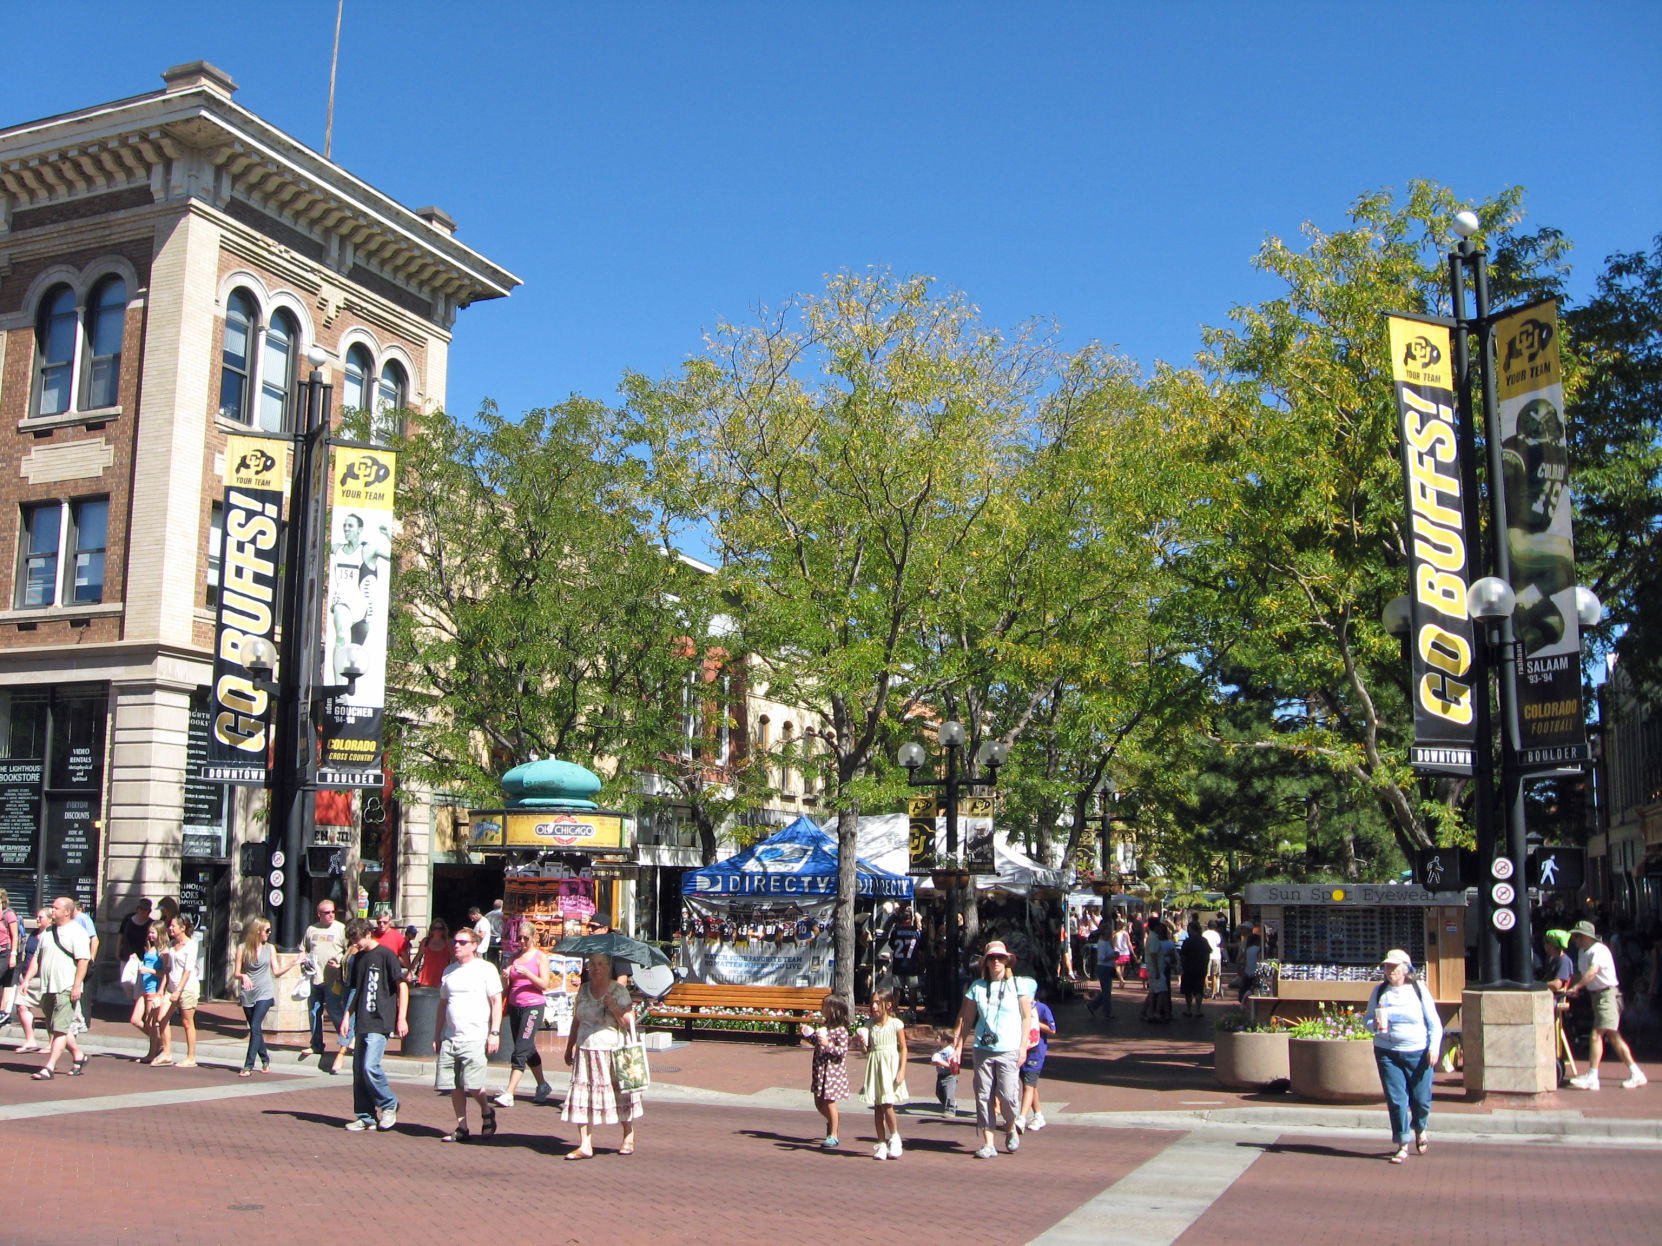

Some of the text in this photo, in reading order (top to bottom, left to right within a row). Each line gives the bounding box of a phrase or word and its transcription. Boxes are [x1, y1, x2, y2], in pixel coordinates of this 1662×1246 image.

[1406, 369, 1441, 383] YOUR TEAM
[1505, 361, 1551, 387] YOUR TEAM
[236, 477, 271, 487] YOUR TEAM
[342, 489, 385, 501] YOUR TEAM
[1402, 387, 1473, 725] GO BUFFS!
[214, 490, 278, 753] GO BUFFS!
[1527, 656, 1569, 674] SALAAM
[334, 706, 374, 718] GOUCHER
[1524, 699, 1578, 720] COLORADO
[1532, 718, 1575, 735] FOOTBALL
[327, 738, 377, 752] COLORADO
[69, 756, 92, 764] RENTALS
[328, 752, 375, 762] CROSS COUNTRY
[1417, 749, 1472, 764] DOWNTOWN
[1528, 747, 1577, 762] BOULDER
[209, 768, 266, 780] DOWNTOWN
[326, 773, 375, 784] BOULDER
[64, 811, 90, 820] DISCOUNTS
[554, 825, 593, 835] CHICAGO
[729, 875, 831, 893] DIRECTV
[1268, 888, 1301, 901] Sun
[1363, 888, 1438, 904] Eyewear
[894, 939, 917, 959] 27
